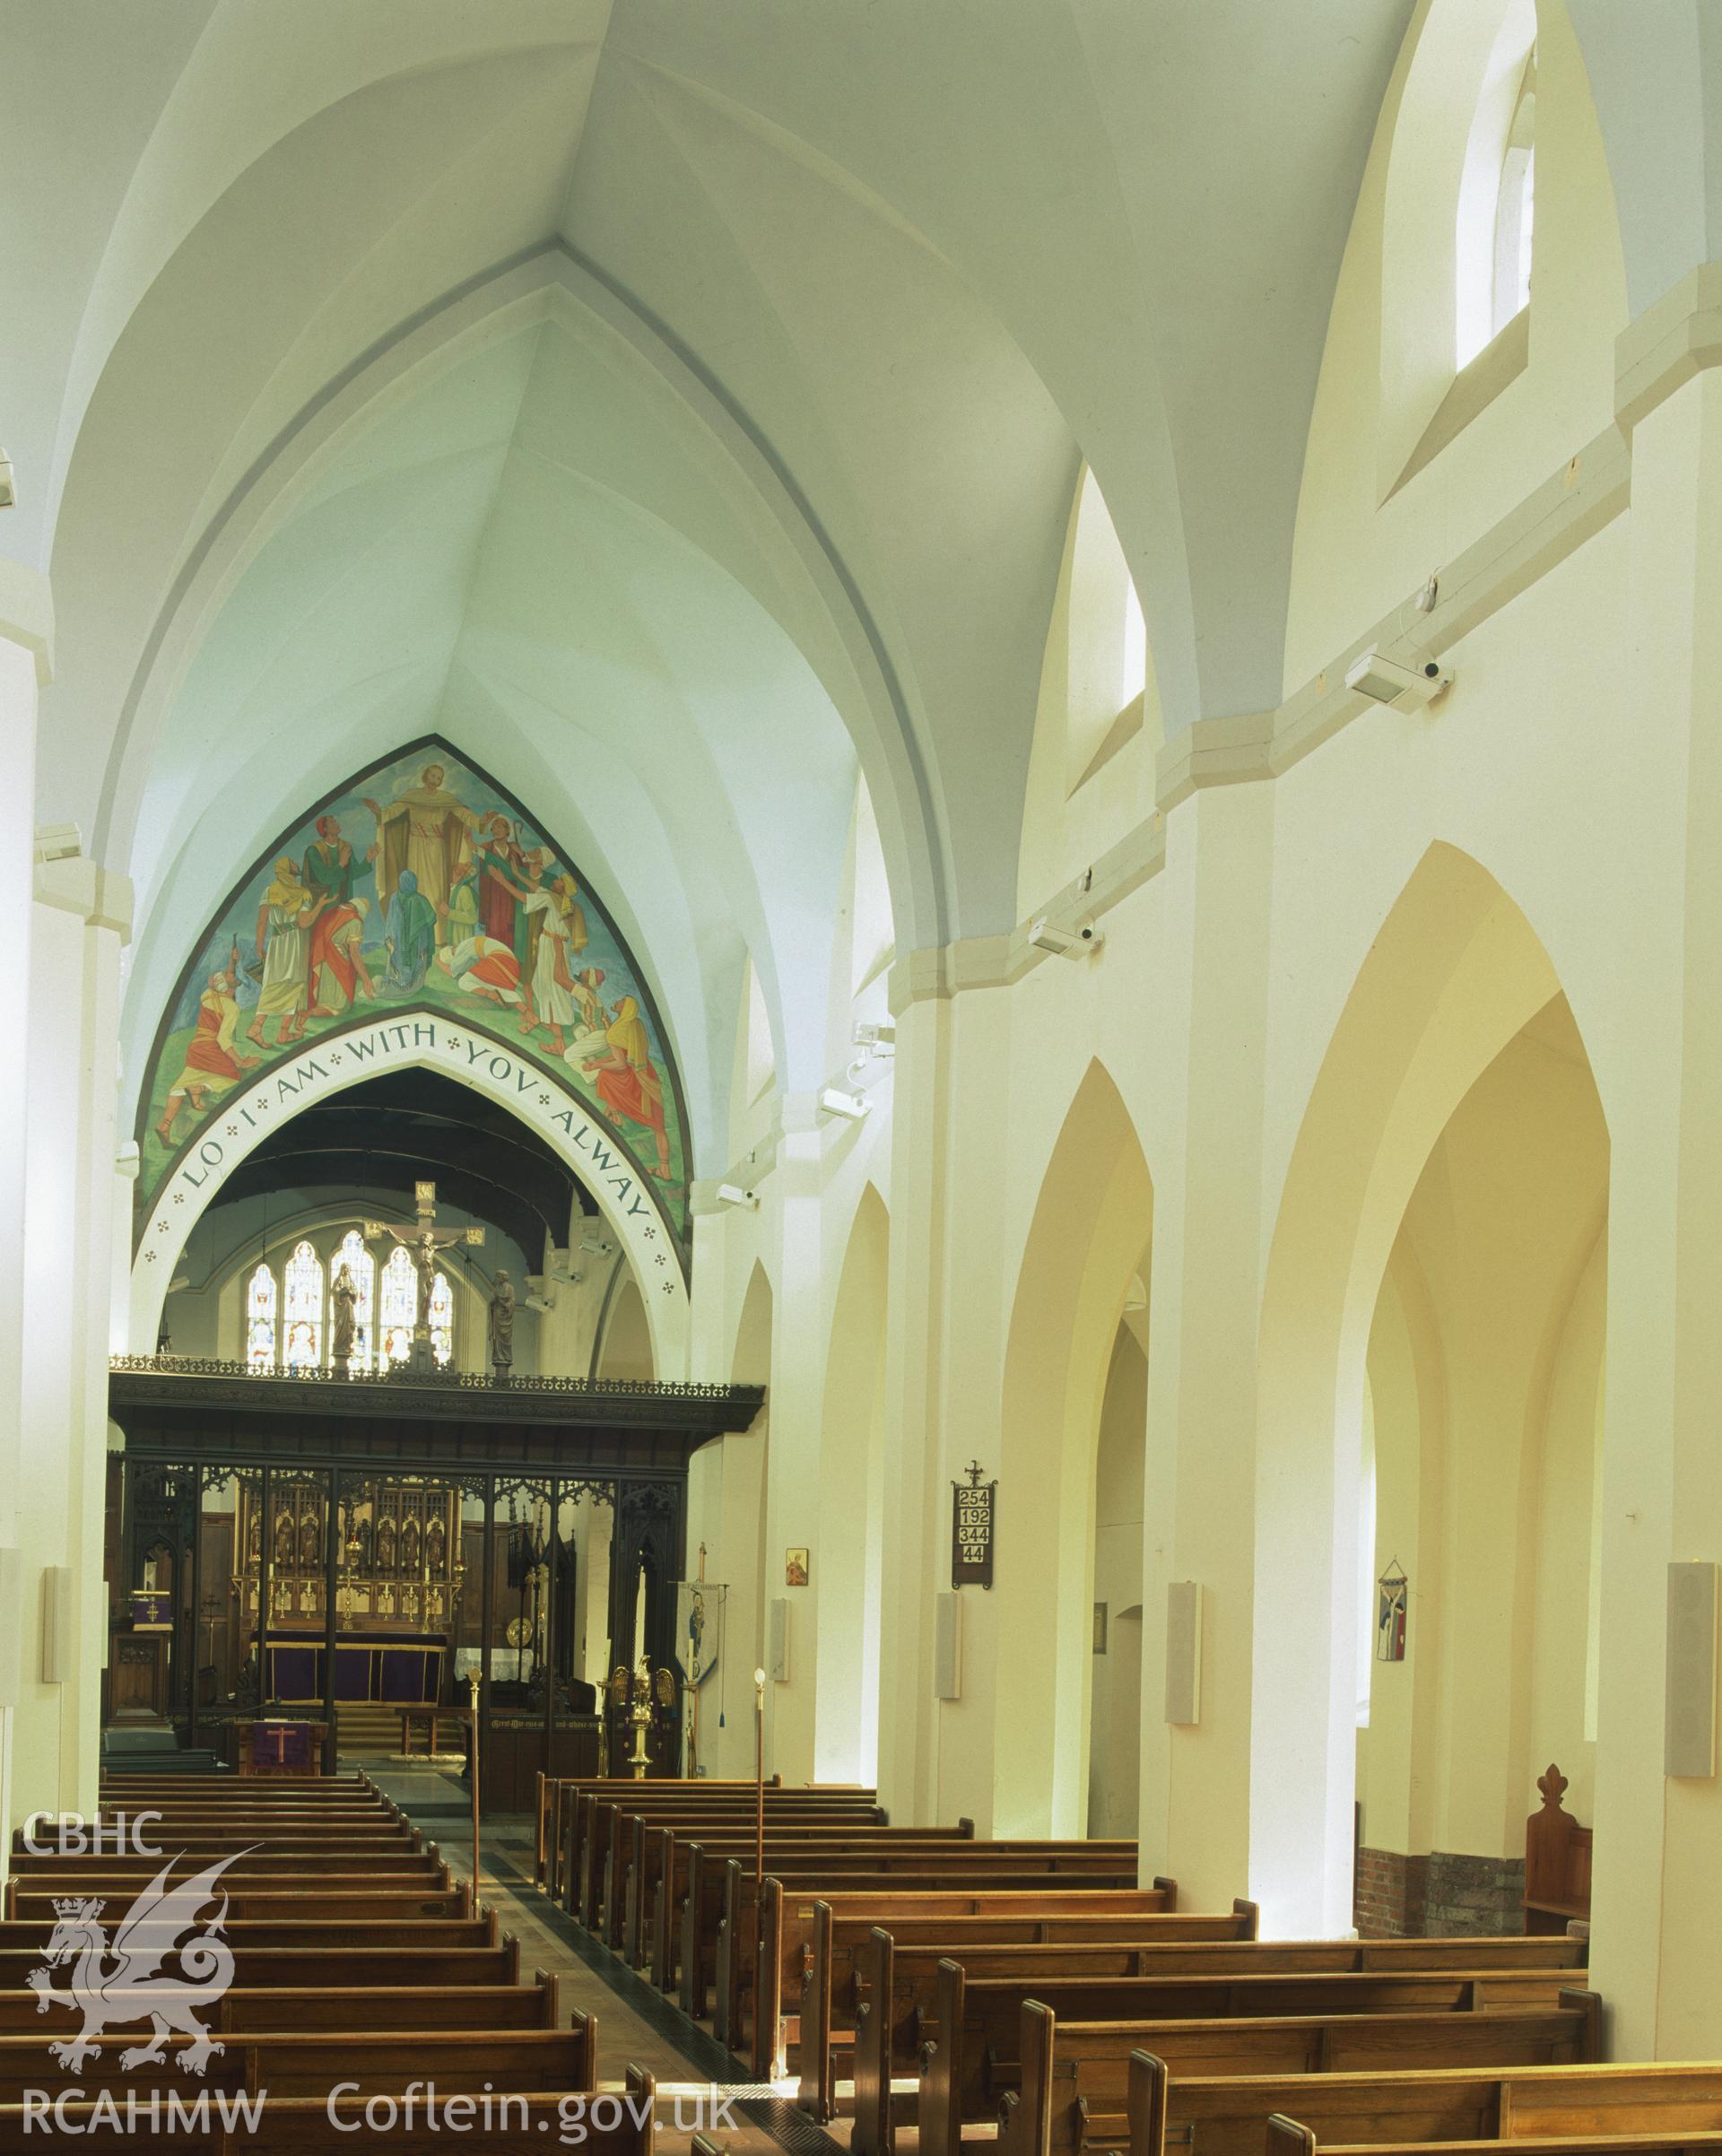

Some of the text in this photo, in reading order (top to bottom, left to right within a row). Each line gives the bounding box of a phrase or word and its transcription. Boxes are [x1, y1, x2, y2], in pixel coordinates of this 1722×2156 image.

[182, 1141, 223, 1188] LO
[239, 1108, 257, 1127] I
[276, 1060, 330, 1103] AM
[344, 1023, 435, 1062] WITH
[551, 1110, 652, 1219] ALWAY
[960, 1491, 988, 1505] 254
[961, 1509, 989, 1524] 192
[960, 1528, 988, 1543] 344
[963, 1546, 983, 1560] 44
